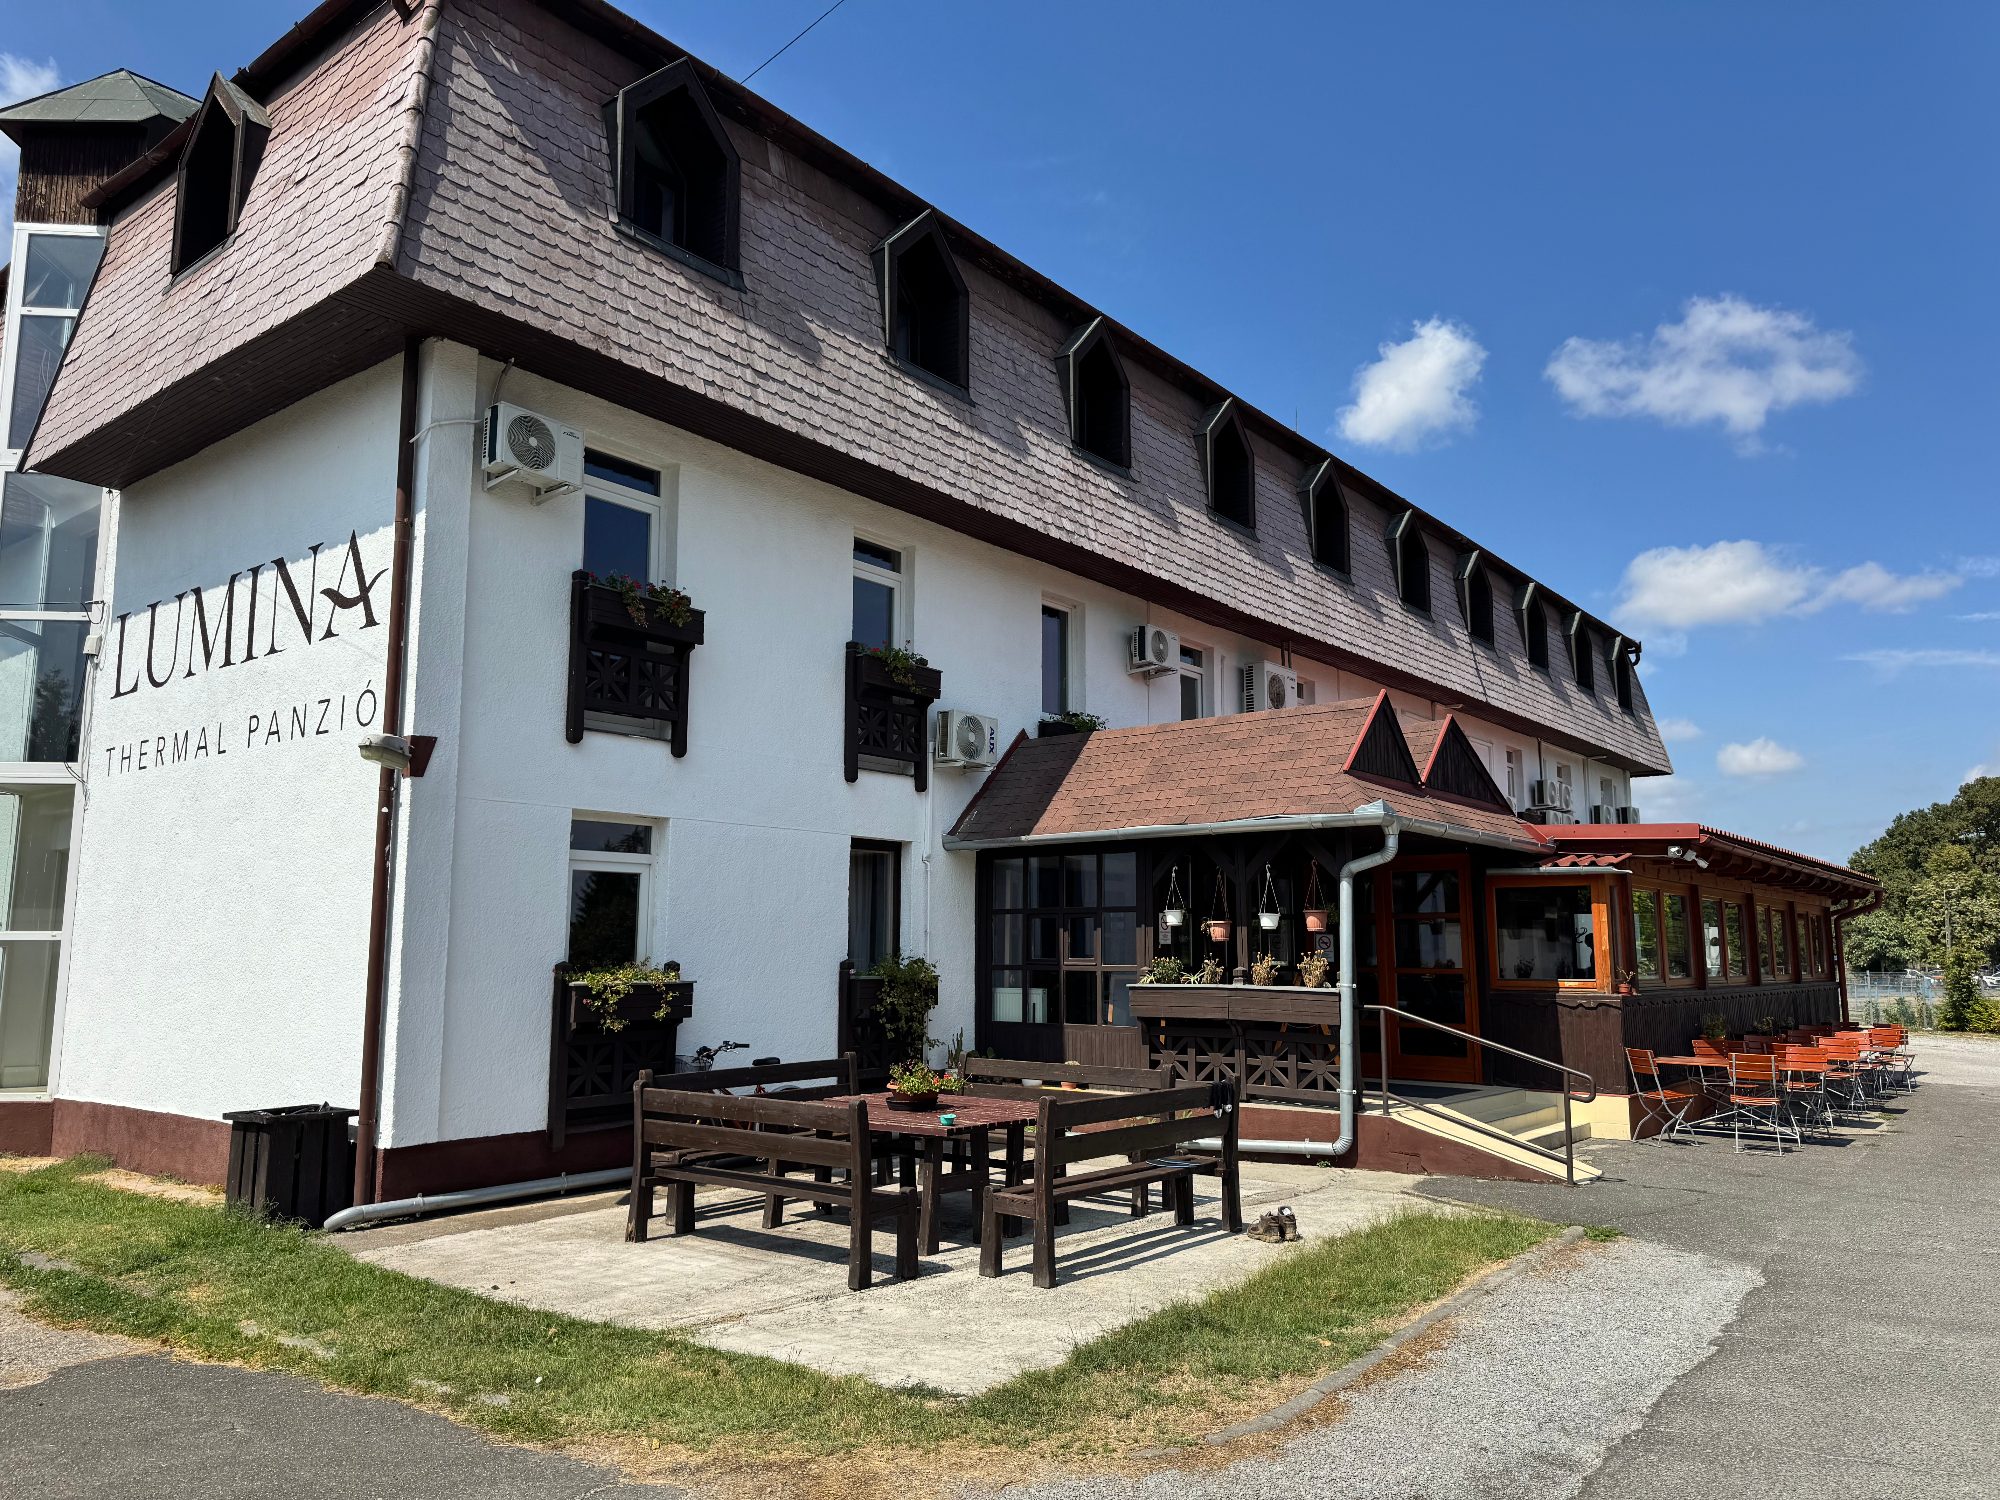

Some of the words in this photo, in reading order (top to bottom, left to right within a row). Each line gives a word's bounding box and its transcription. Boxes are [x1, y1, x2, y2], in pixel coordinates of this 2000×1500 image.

[111, 530, 389, 700] LUMINA
[106, 722, 227, 777] THERMAL
[247, 680, 377, 749] PANZIÓ
